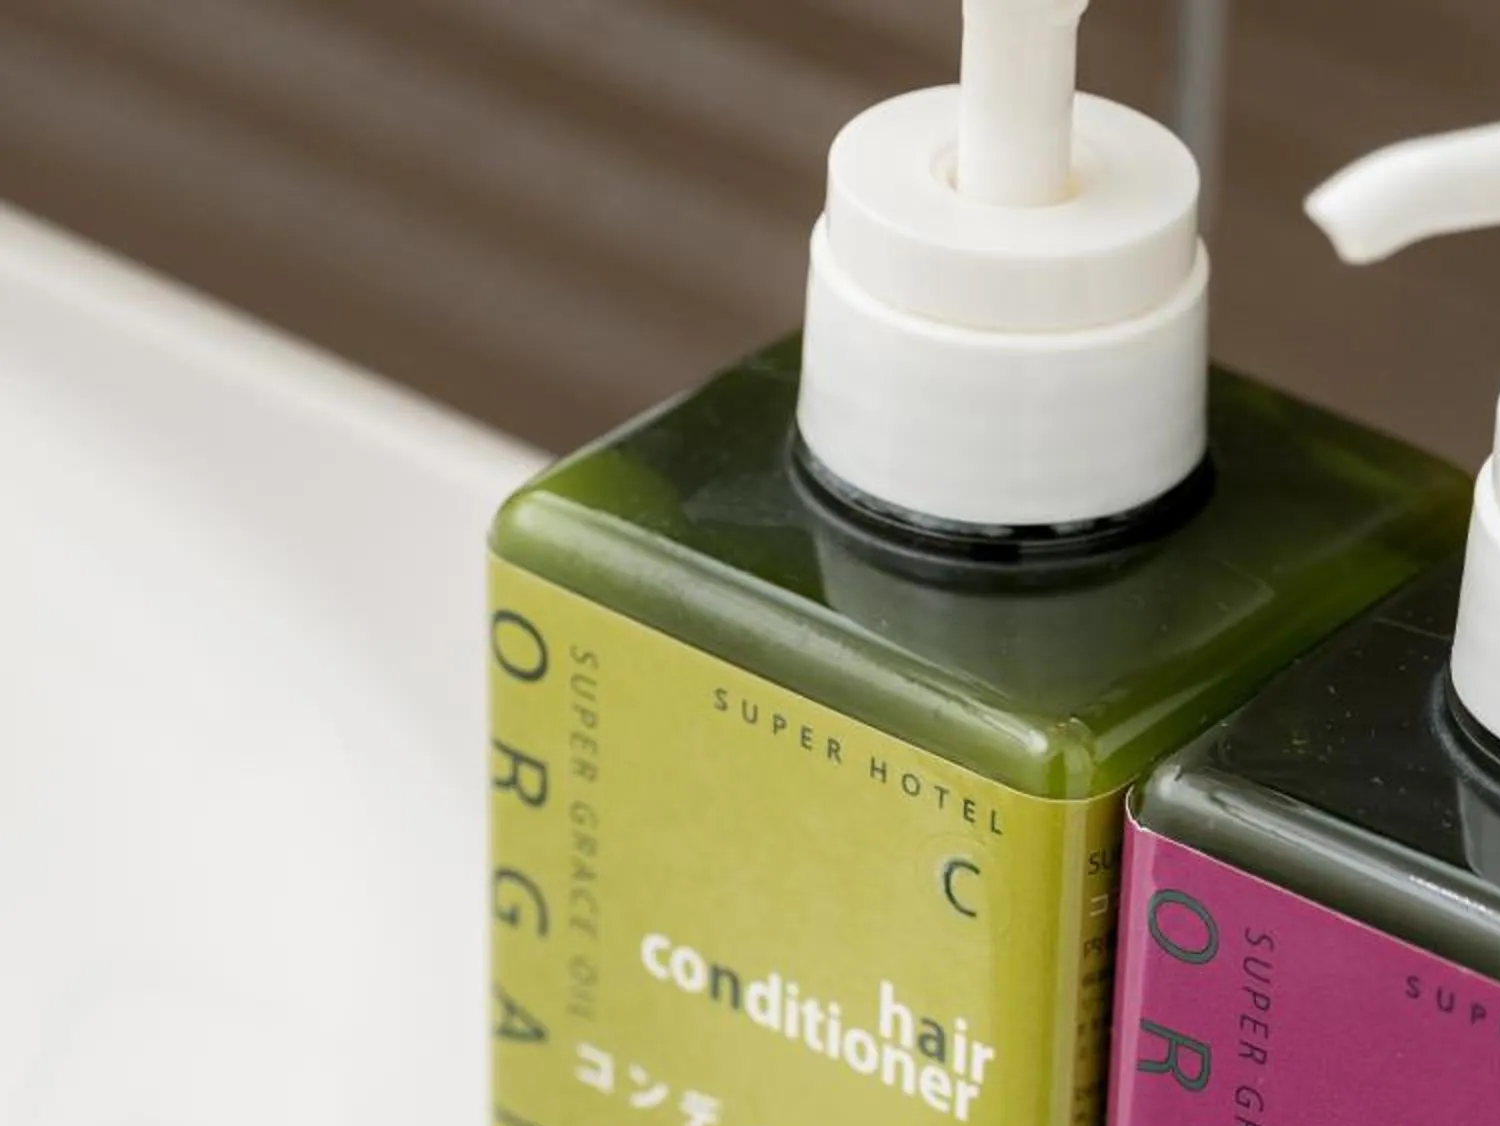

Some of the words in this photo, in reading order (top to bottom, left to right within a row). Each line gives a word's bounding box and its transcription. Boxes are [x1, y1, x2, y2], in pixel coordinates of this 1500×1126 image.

[568, 645, 599, 784] SUPER
[713, 687, 843, 763] SUPER
[868, 756, 1004, 836] HOTEL
[567, 800, 598, 939] GRACE
[942, 857, 982, 918] C
[639, 932, 982, 1122] conditioner
[879, 980, 996, 1086] hair
[1237, 926, 1275, 1064] SUPER
